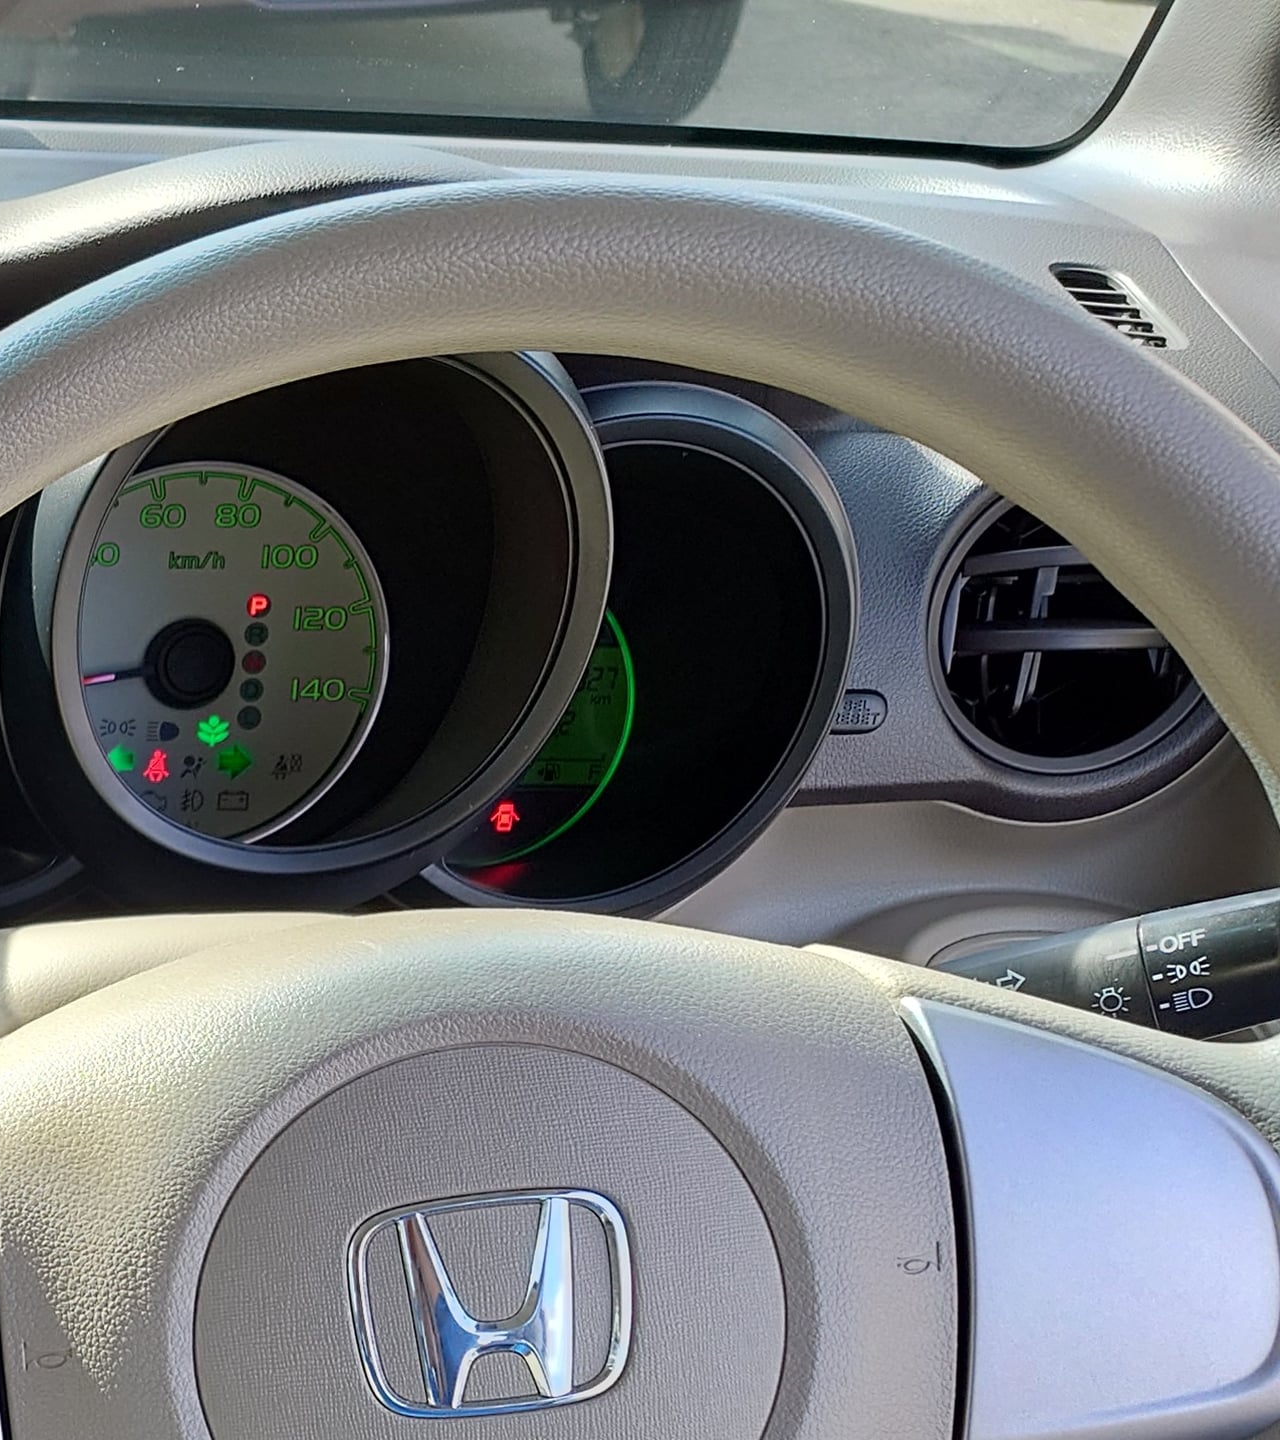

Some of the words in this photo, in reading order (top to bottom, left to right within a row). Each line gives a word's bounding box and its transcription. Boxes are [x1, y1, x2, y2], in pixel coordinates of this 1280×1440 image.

[139, 504, 186, 529] 60
[214, 504, 262, 529] 80
[91, 541, 120, 567] 0
[168, 550, 226, 570] km/h
[261, 543, 318, 569] 100
[250, 596, 268, 616] P
[293, 606, 348, 631] 120
[290, 678, 345, 702] 140
[1158, 928, 1207, 953] OFF
